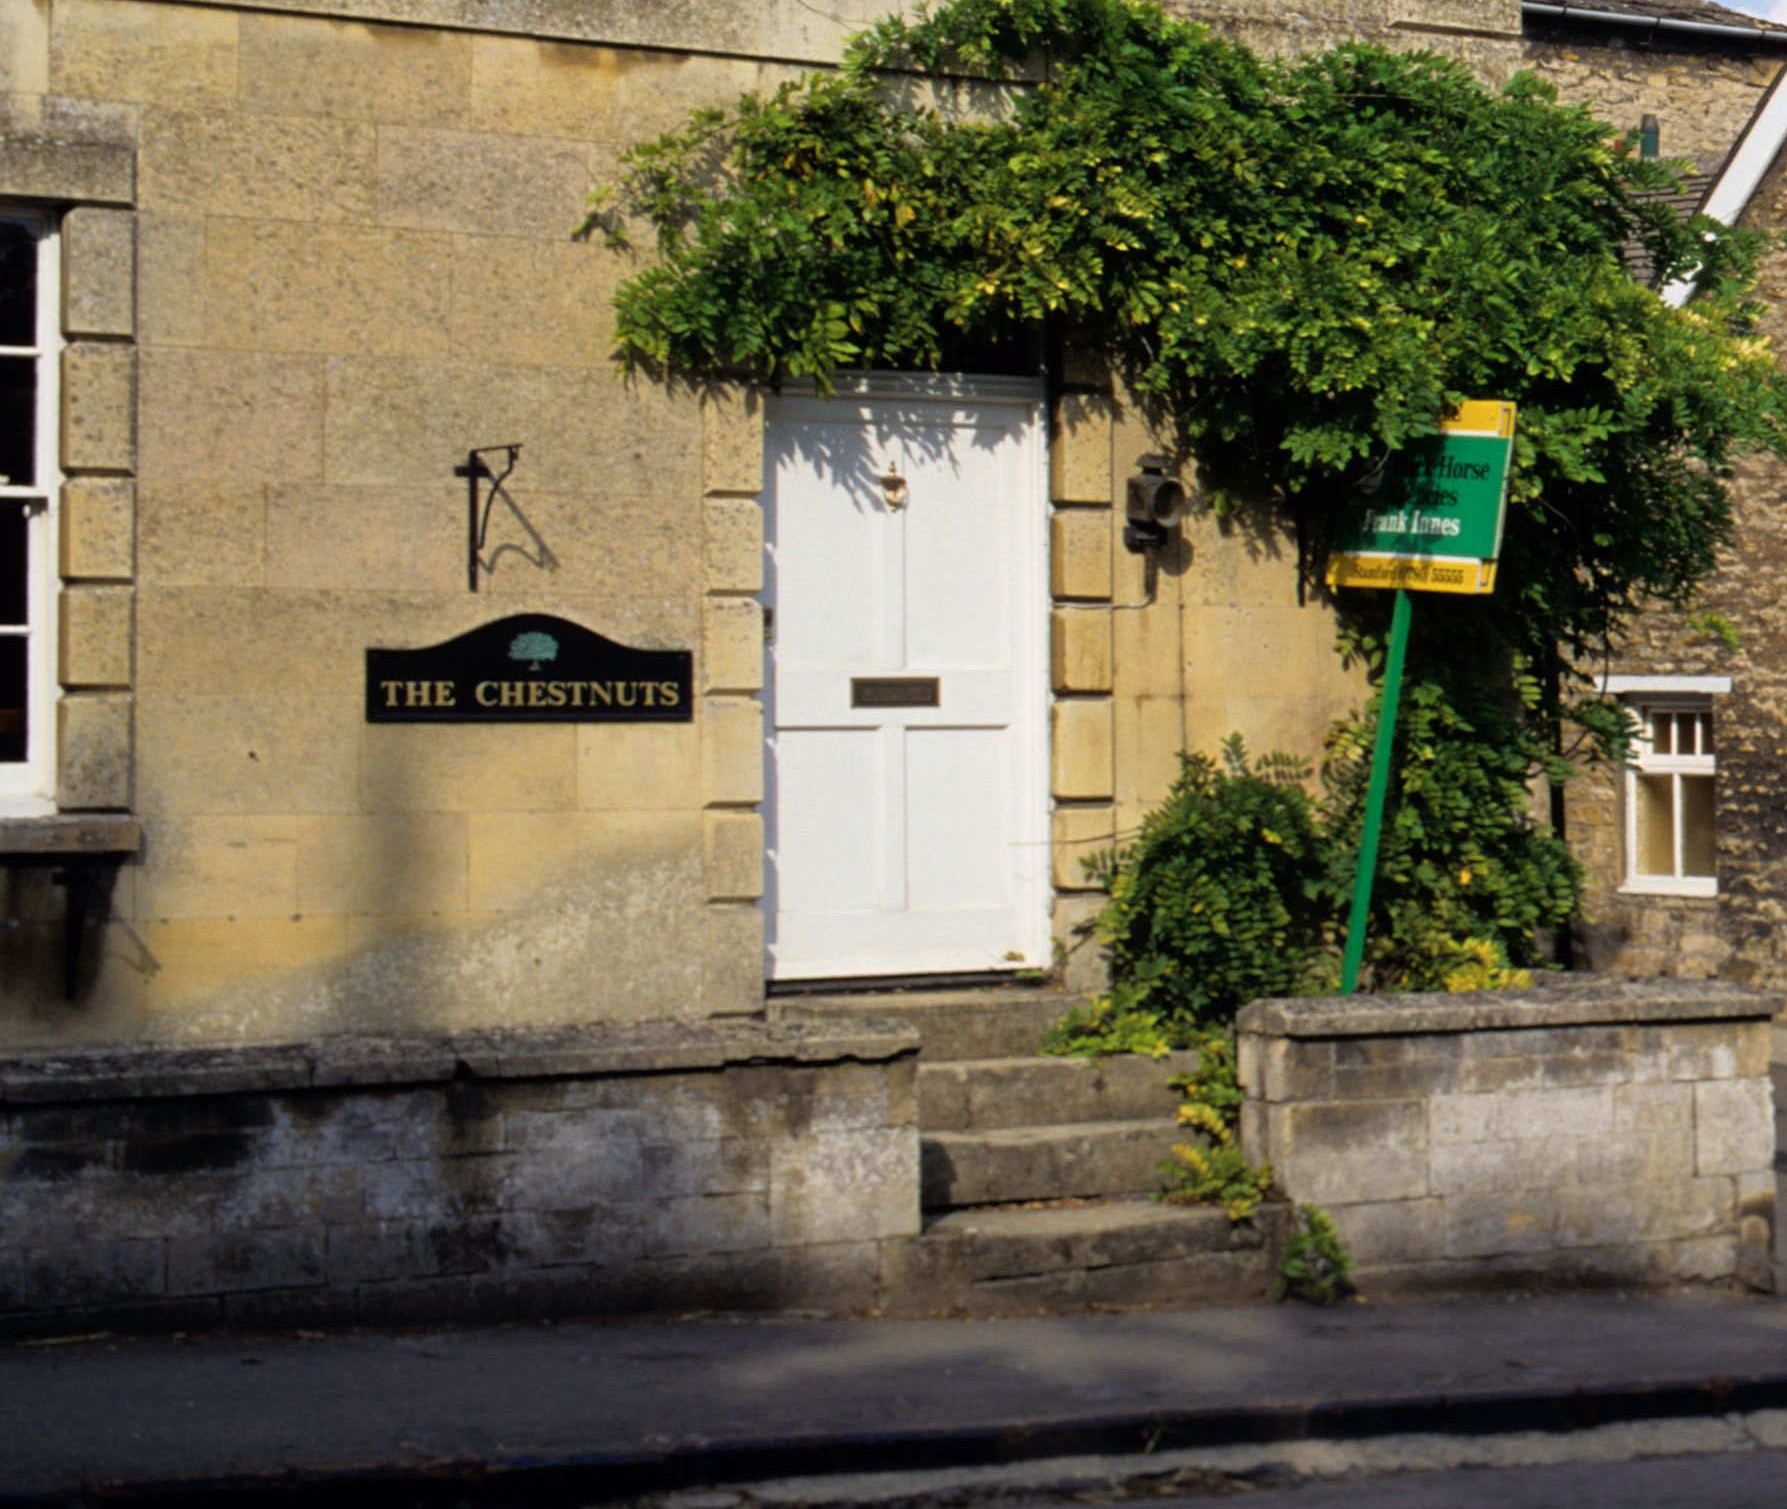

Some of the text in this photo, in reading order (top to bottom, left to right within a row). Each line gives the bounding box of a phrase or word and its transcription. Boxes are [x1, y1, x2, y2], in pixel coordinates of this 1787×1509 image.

[1440, 455, 1490, 480] Horse
[1363, 509, 1461, 536] Frank Innes
[380, 680, 680, 707] THE CHESTNUTS
